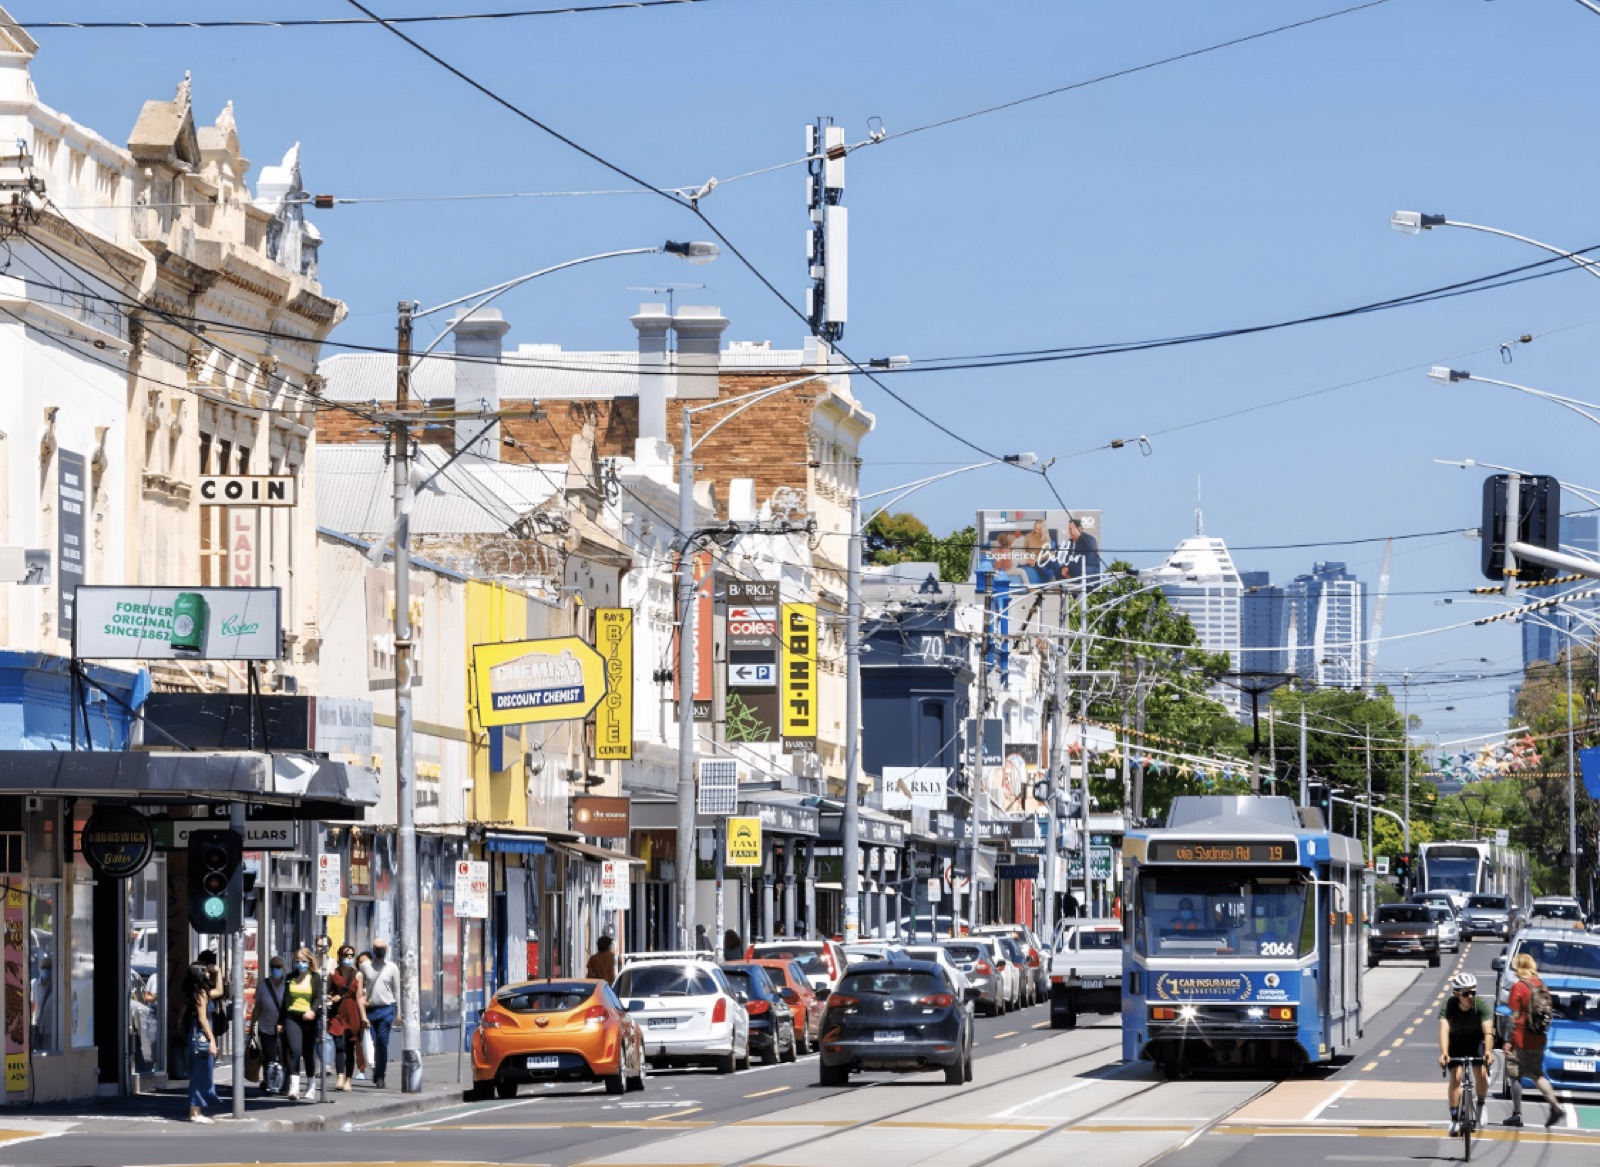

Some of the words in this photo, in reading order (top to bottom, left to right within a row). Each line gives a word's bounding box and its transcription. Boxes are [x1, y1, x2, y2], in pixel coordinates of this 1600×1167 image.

[201, 480, 285, 500] COIN
[985, 550, 1036, 561] Experience
[116, 602, 173, 617] FOREVER
[604, 612, 625, 622] RAY'S
[112, 614, 173, 630] ORIGINAL
[730, 622, 775, 635] coles
[104, 624, 139, 638] SINCE
[790, 612, 809, 655] JB
[921, 636, 943, 661] 70
[606, 624, 623, 743] BICYCLE
[497, 692, 542, 708] DISCOUNT
[543, 688, 580, 704] CHEMIST
[599, 745, 628, 755] CENTRE
[1176, 846, 1193, 860] via
[1195, 845, 1233, 860] Sydney
[1235, 847, 1250, 860] Rd
[1269, 846, 1283, 861] 19
[1260, 942, 1295, 956] 2066
[1179, 978, 1195, 988] CAR
[1196, 978, 1241, 988] INSURANCE
